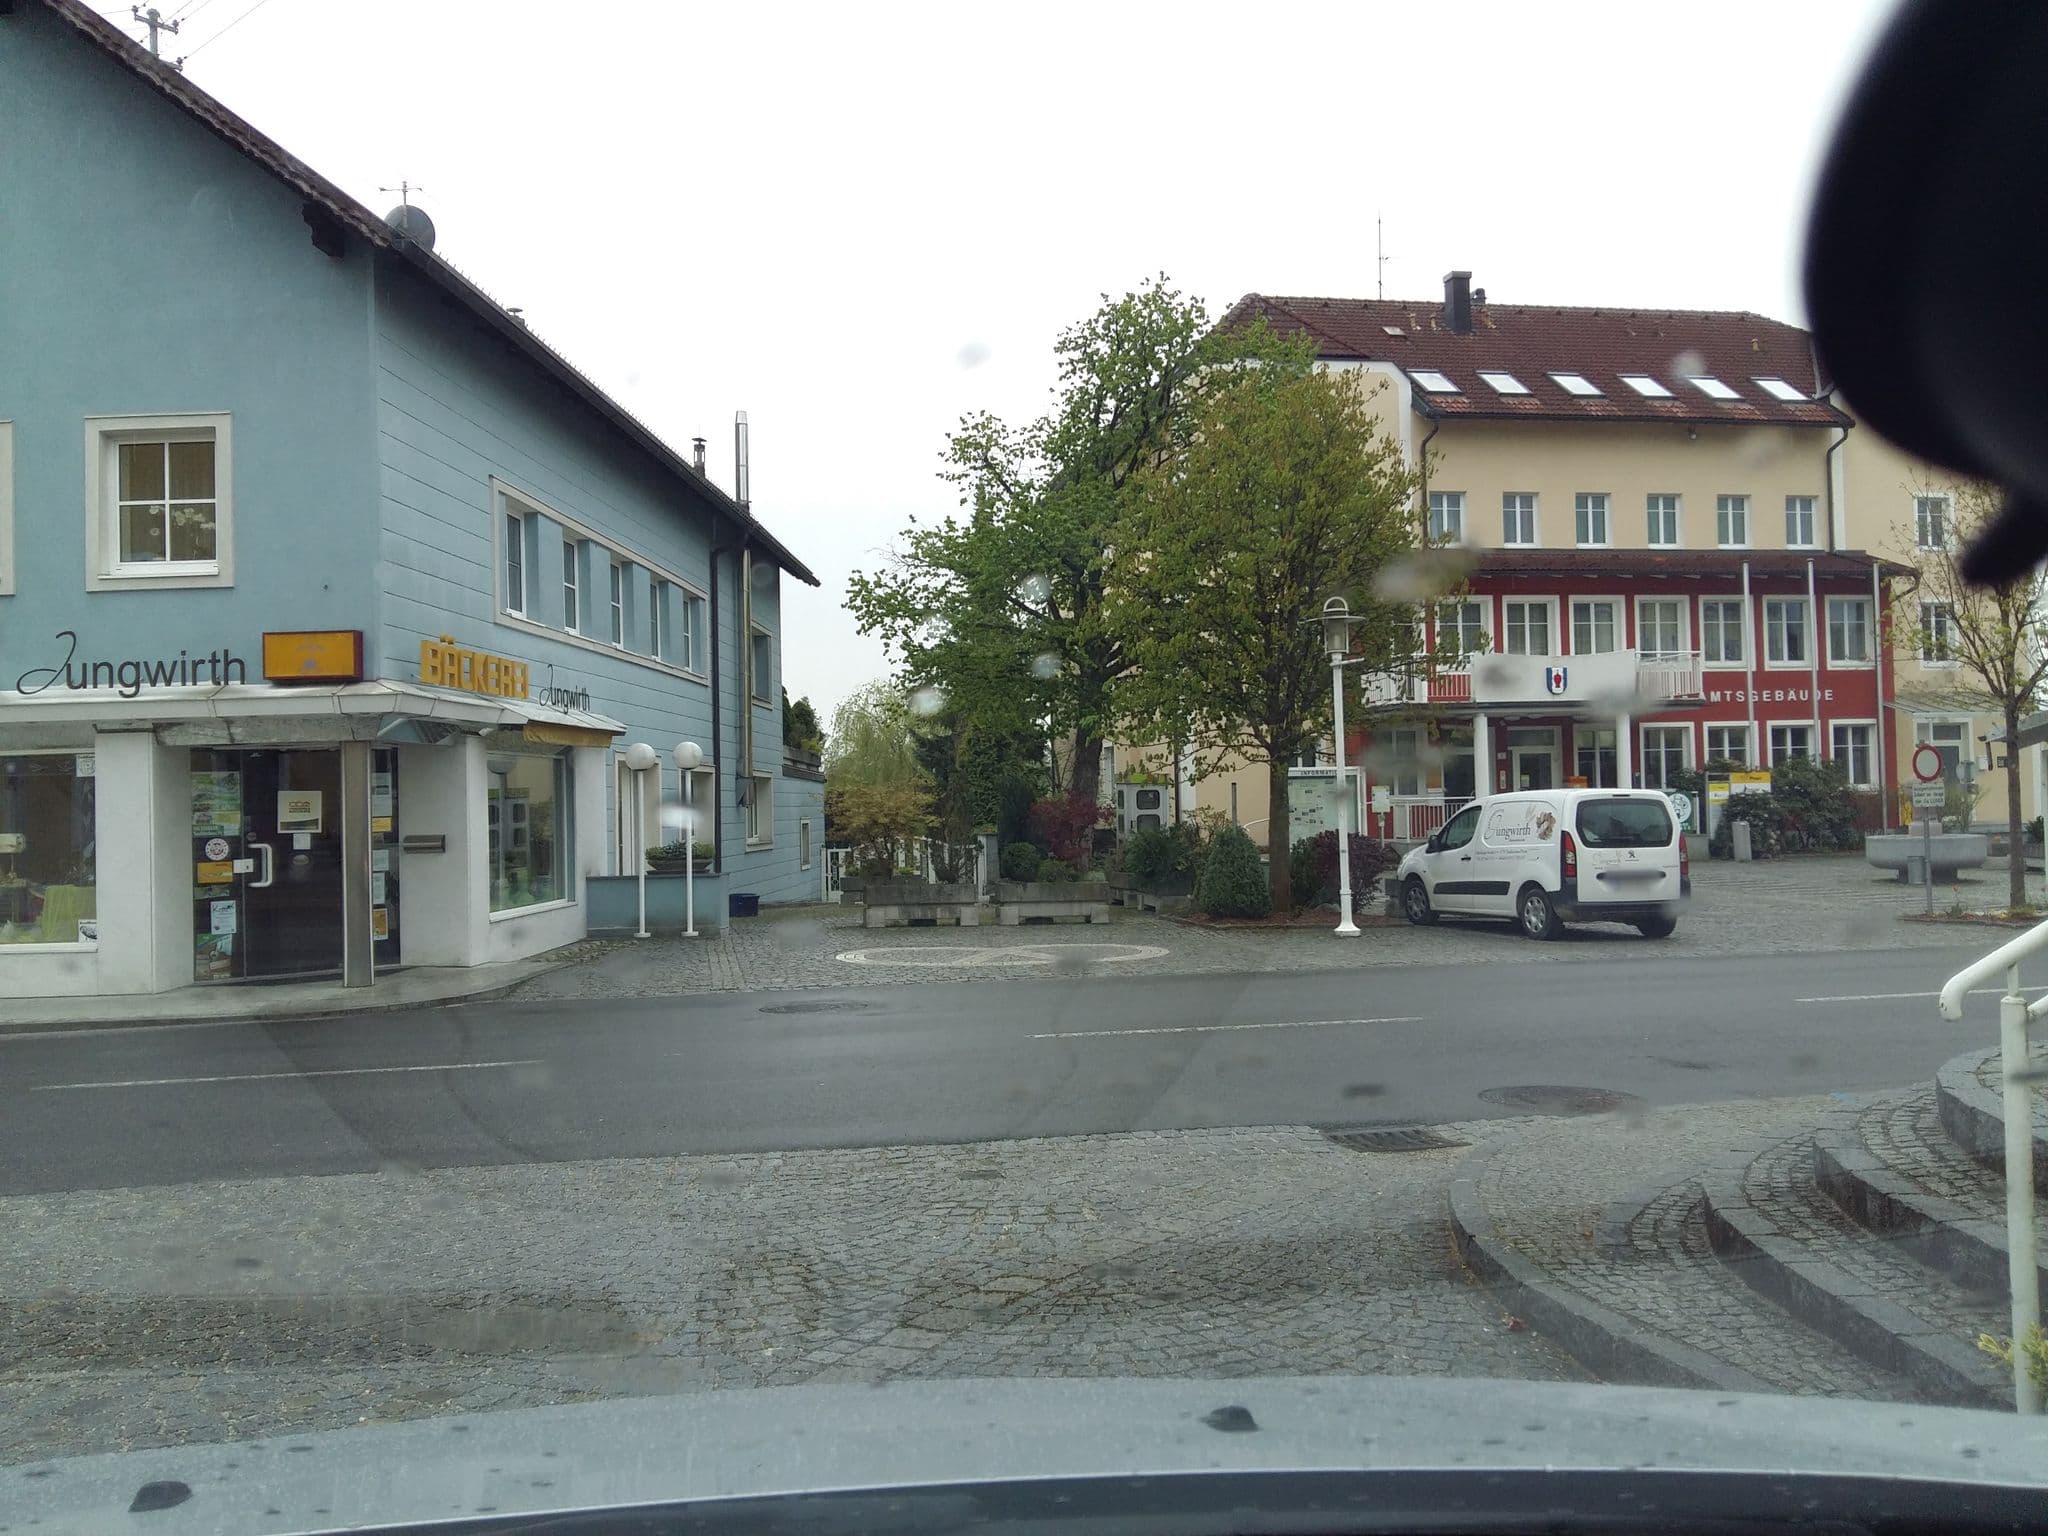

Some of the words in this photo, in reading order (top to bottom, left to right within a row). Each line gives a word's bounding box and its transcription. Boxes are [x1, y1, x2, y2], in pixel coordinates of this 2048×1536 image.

[16, 630, 246, 698] Jungwirth
[420, 634, 530, 700] BÄCKEREI
[538, 663, 591, 715] Jungwirth
